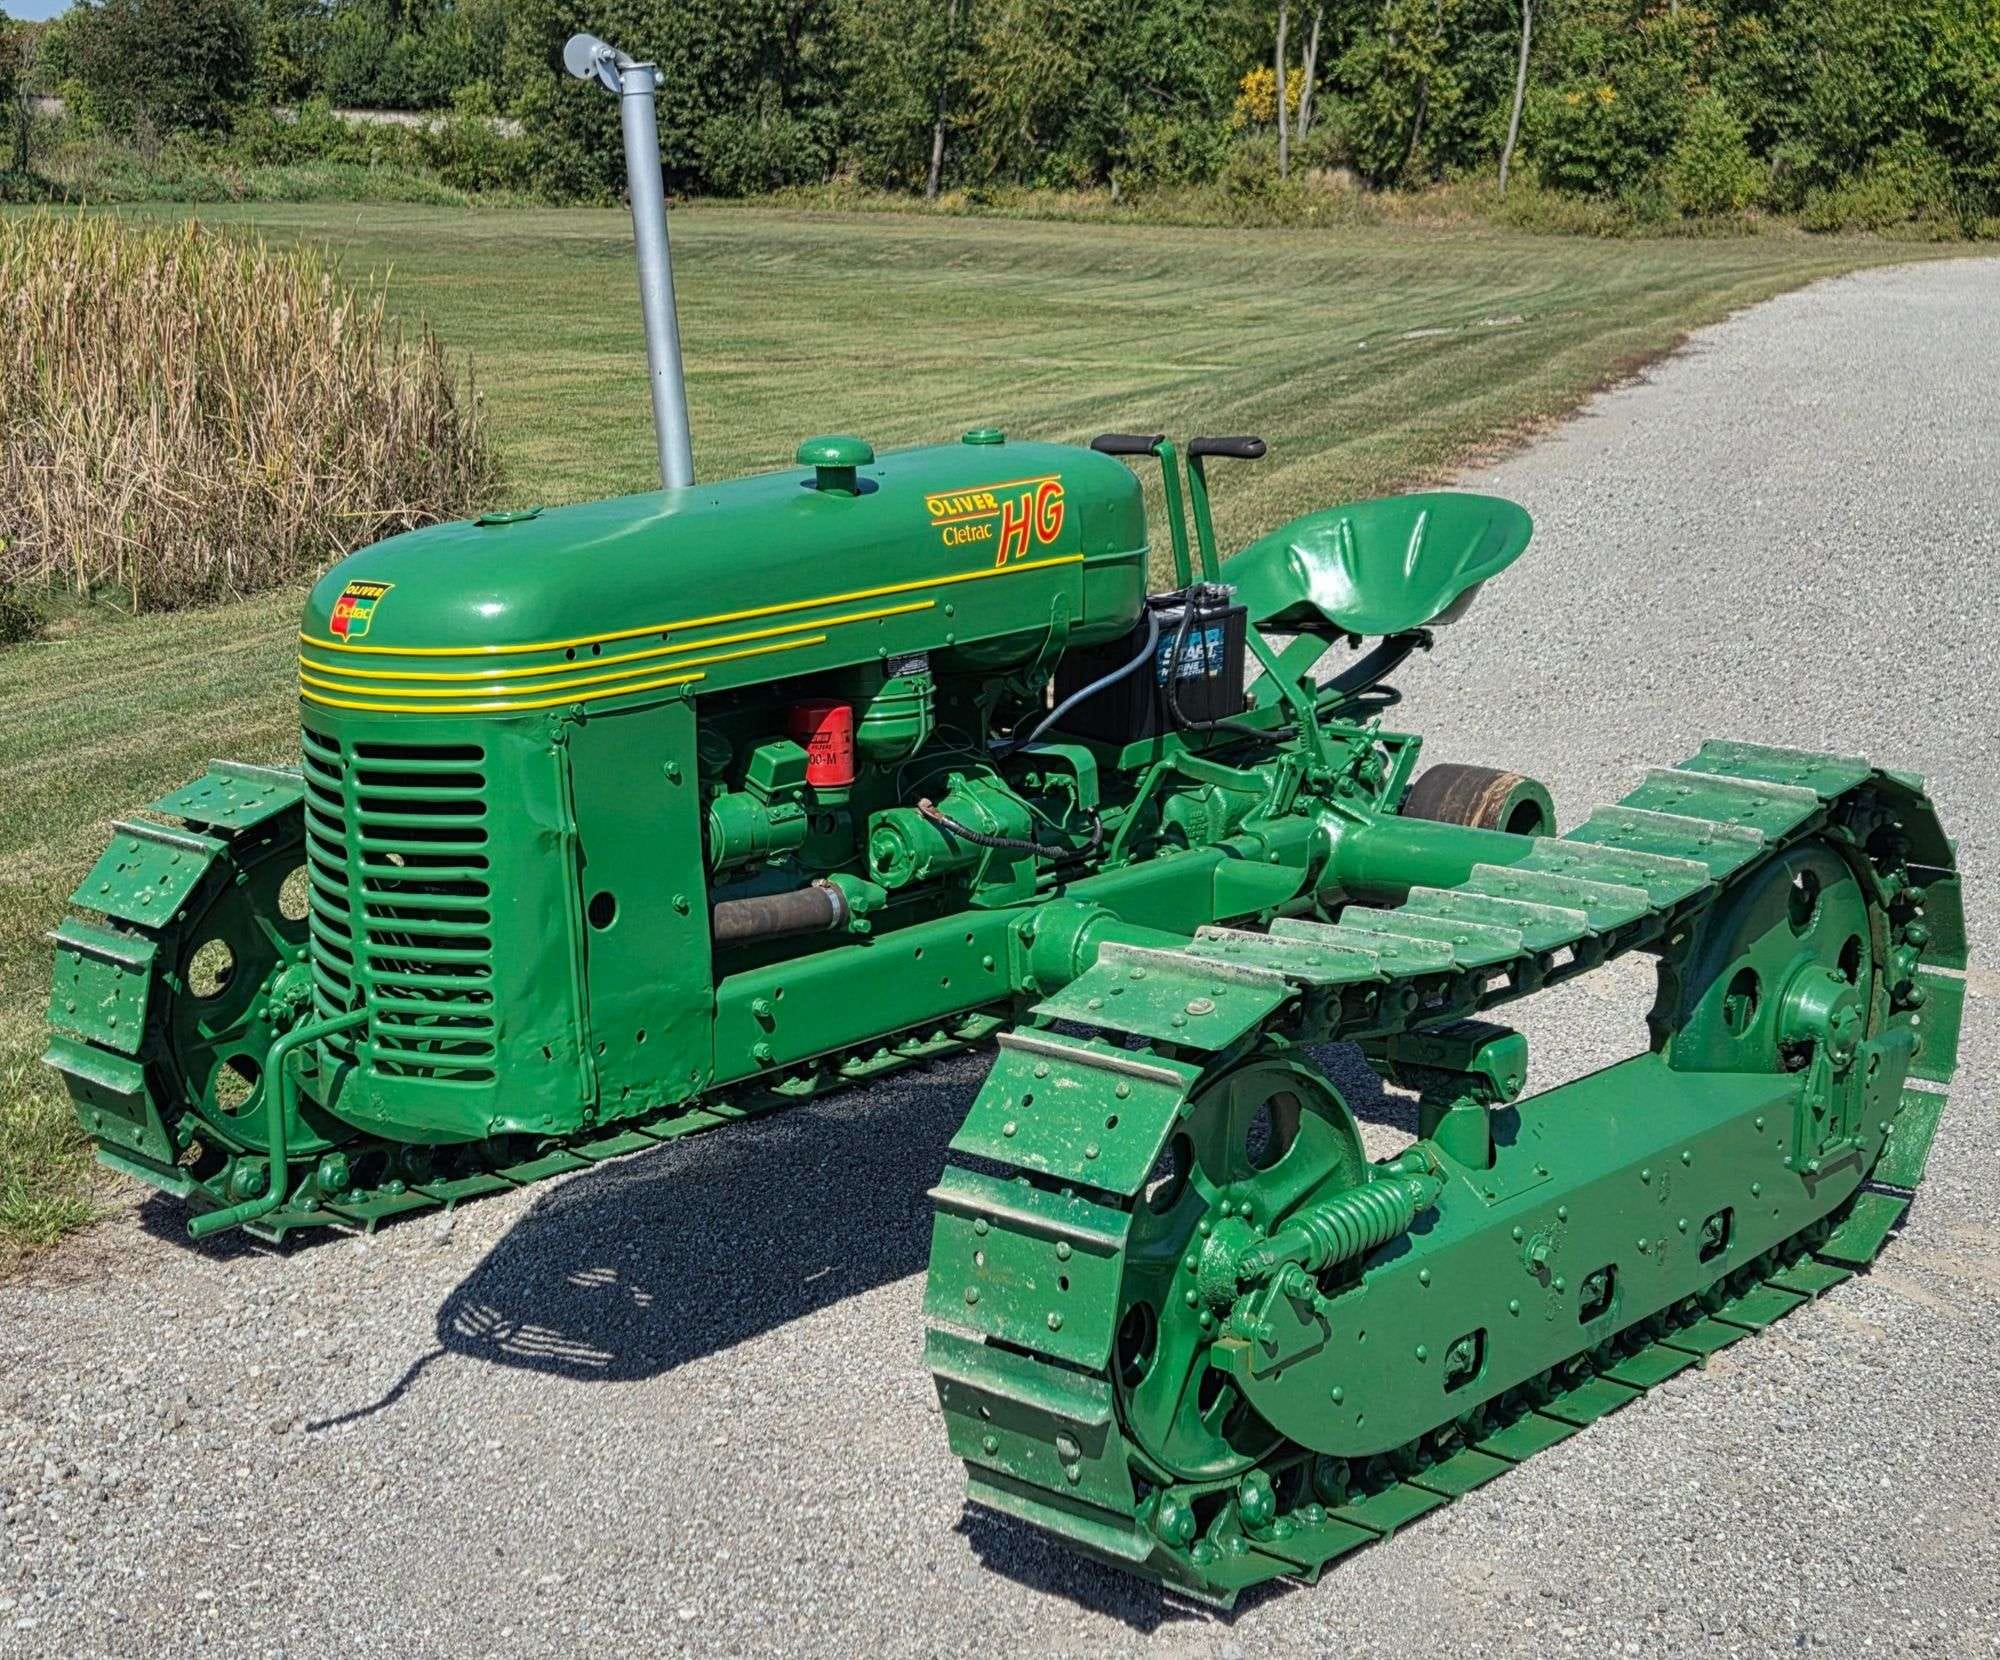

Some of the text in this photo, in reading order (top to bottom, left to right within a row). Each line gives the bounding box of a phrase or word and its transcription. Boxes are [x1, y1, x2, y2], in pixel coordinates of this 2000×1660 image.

[928, 493, 998, 516] OLIVER
[943, 523, 993, 546] Cletrac
[995, 480, 1064, 568] HG
[346, 585, 384, 597] OLIVER
